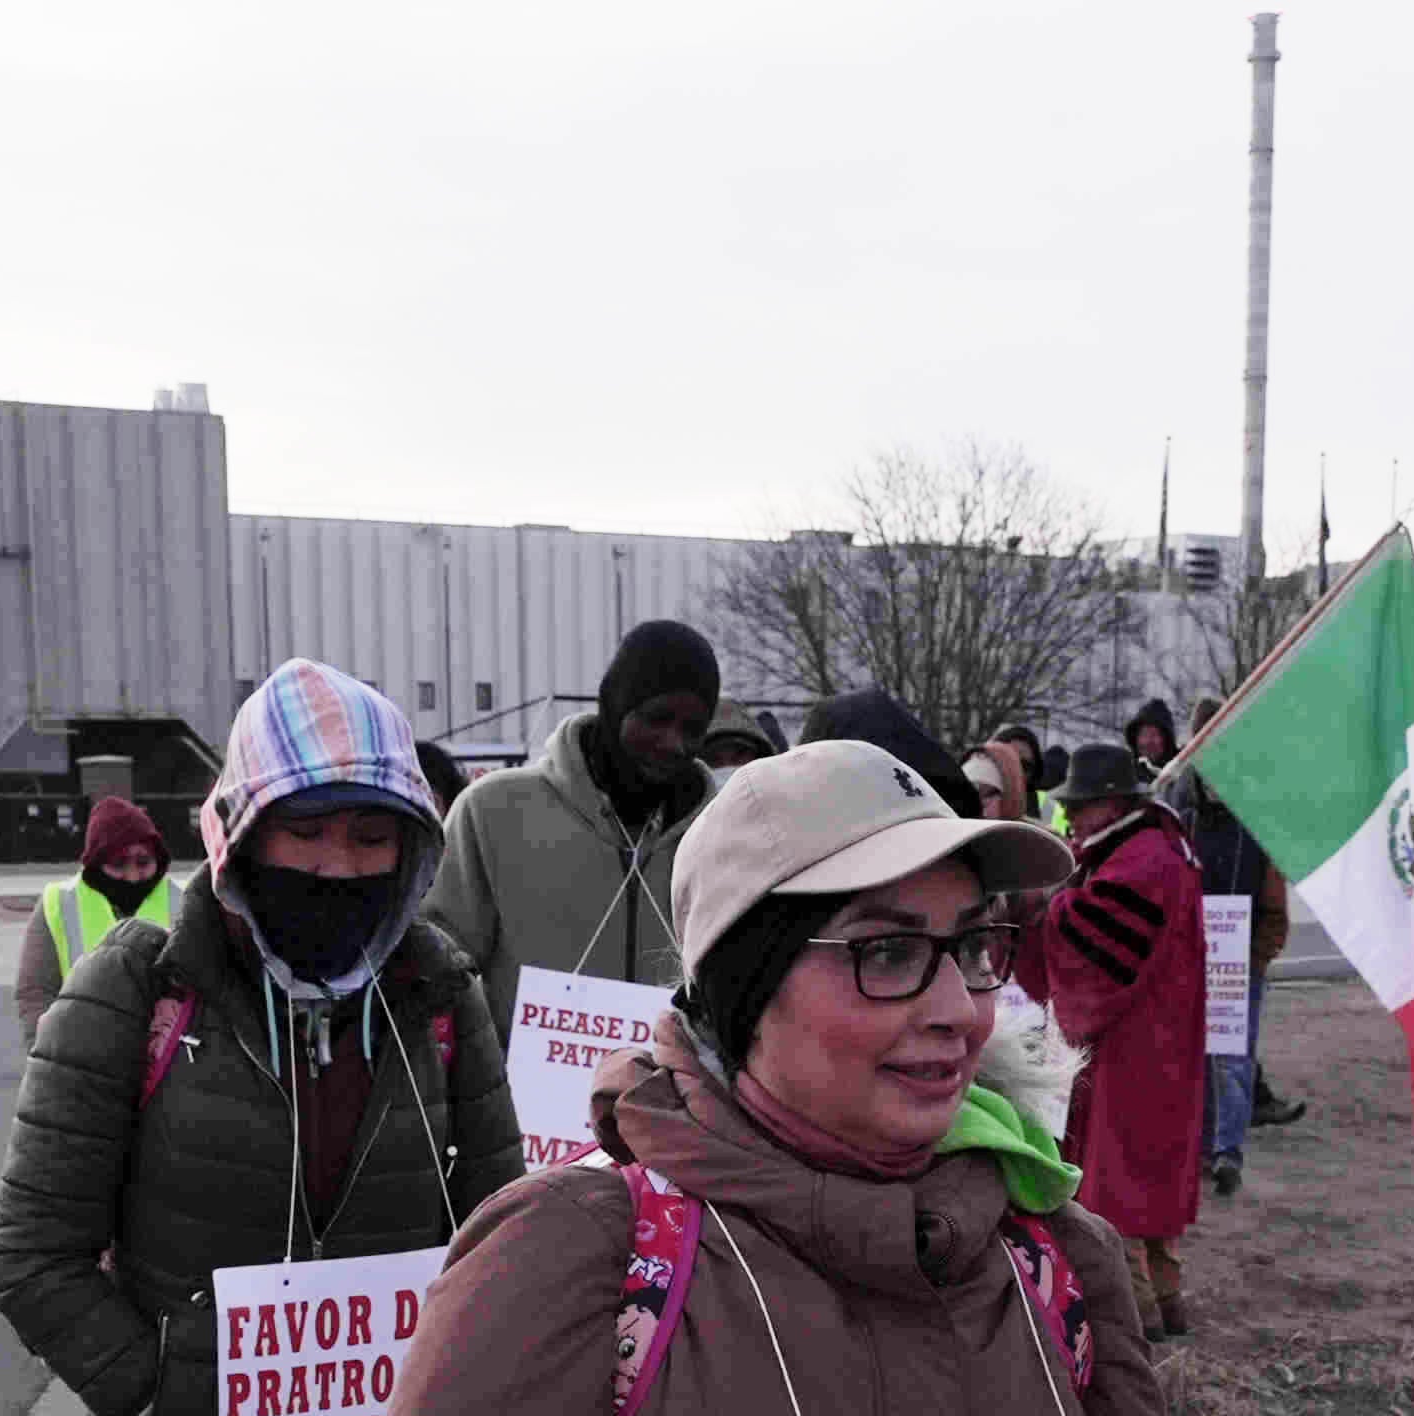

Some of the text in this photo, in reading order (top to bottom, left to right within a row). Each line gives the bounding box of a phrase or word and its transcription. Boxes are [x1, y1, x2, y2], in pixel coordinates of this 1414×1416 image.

[520, 1003, 658, 1043] PLEASE D
[227, 1296, 373, 1361] FAVOR
